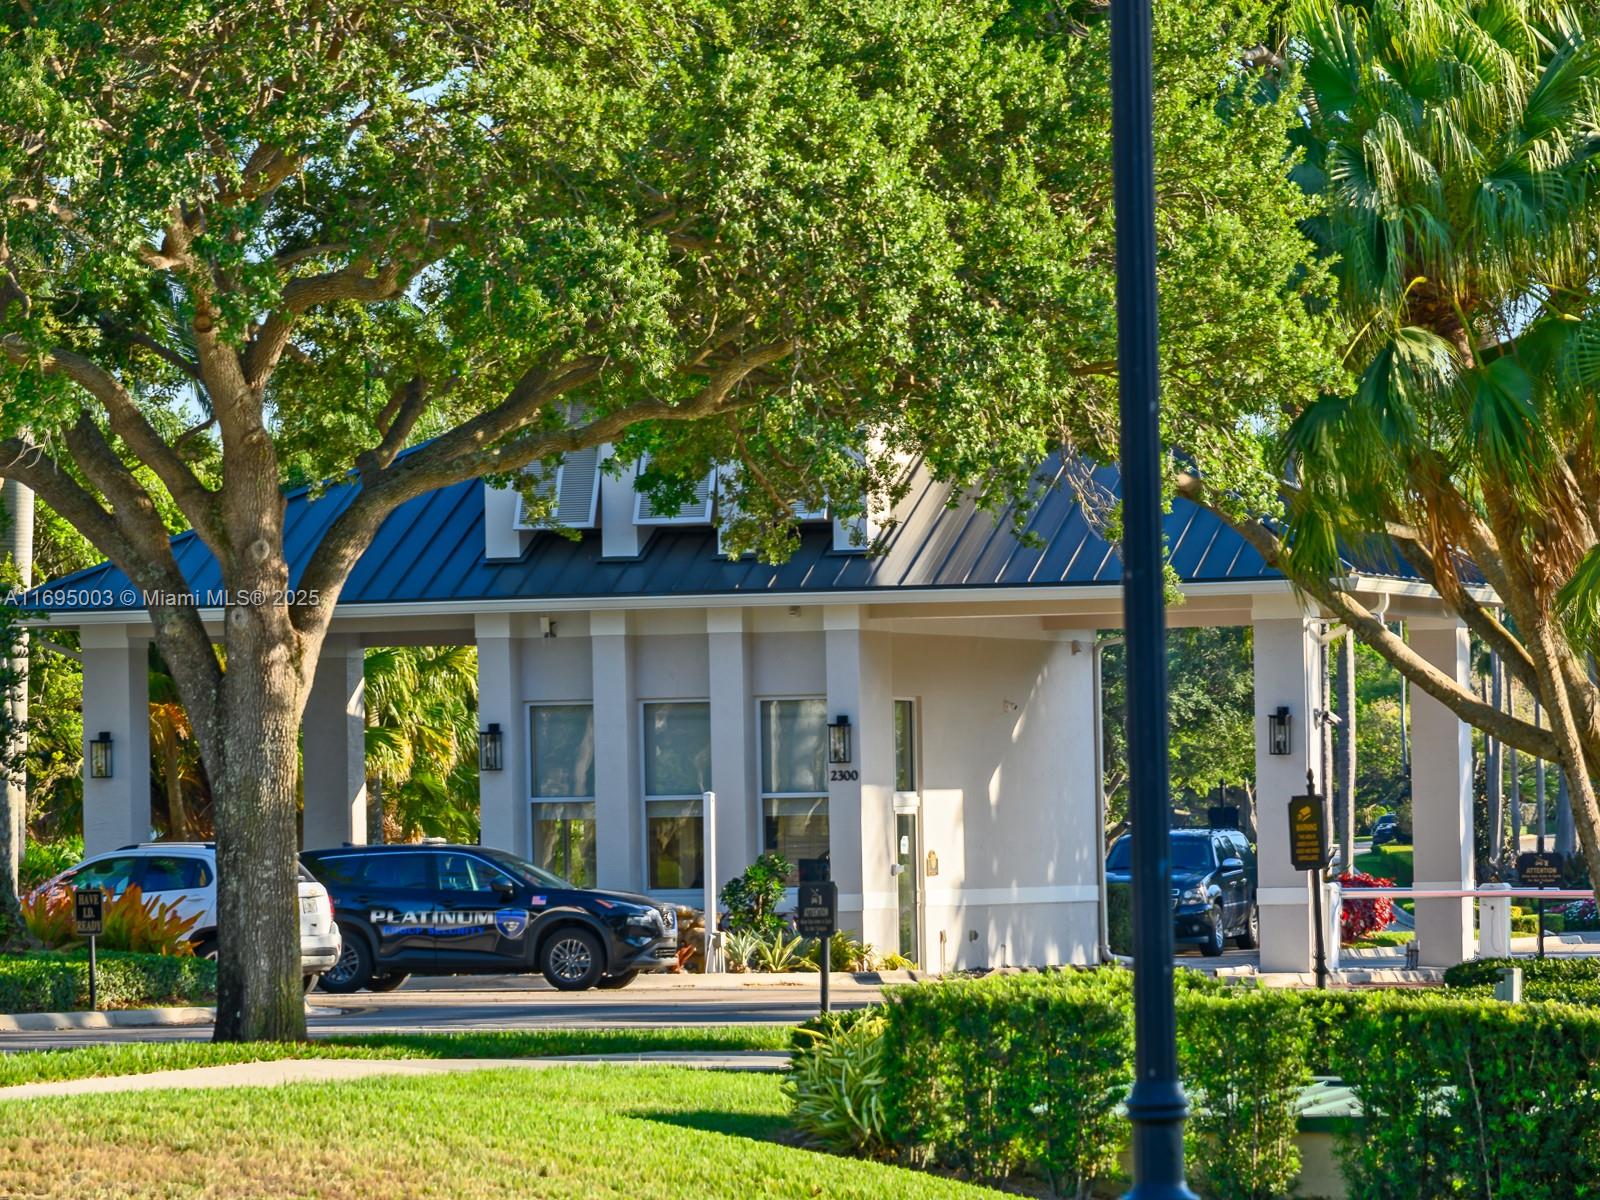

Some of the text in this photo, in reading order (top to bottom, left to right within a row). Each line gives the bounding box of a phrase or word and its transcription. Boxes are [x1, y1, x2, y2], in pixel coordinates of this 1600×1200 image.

[831, 770, 859, 781] 2300
[78, 894, 99, 905] HAVE
[370, 910, 495, 924] PLATINUM
[77, 920, 101, 932] READY
[428, 926, 485, 936] SECURITY
